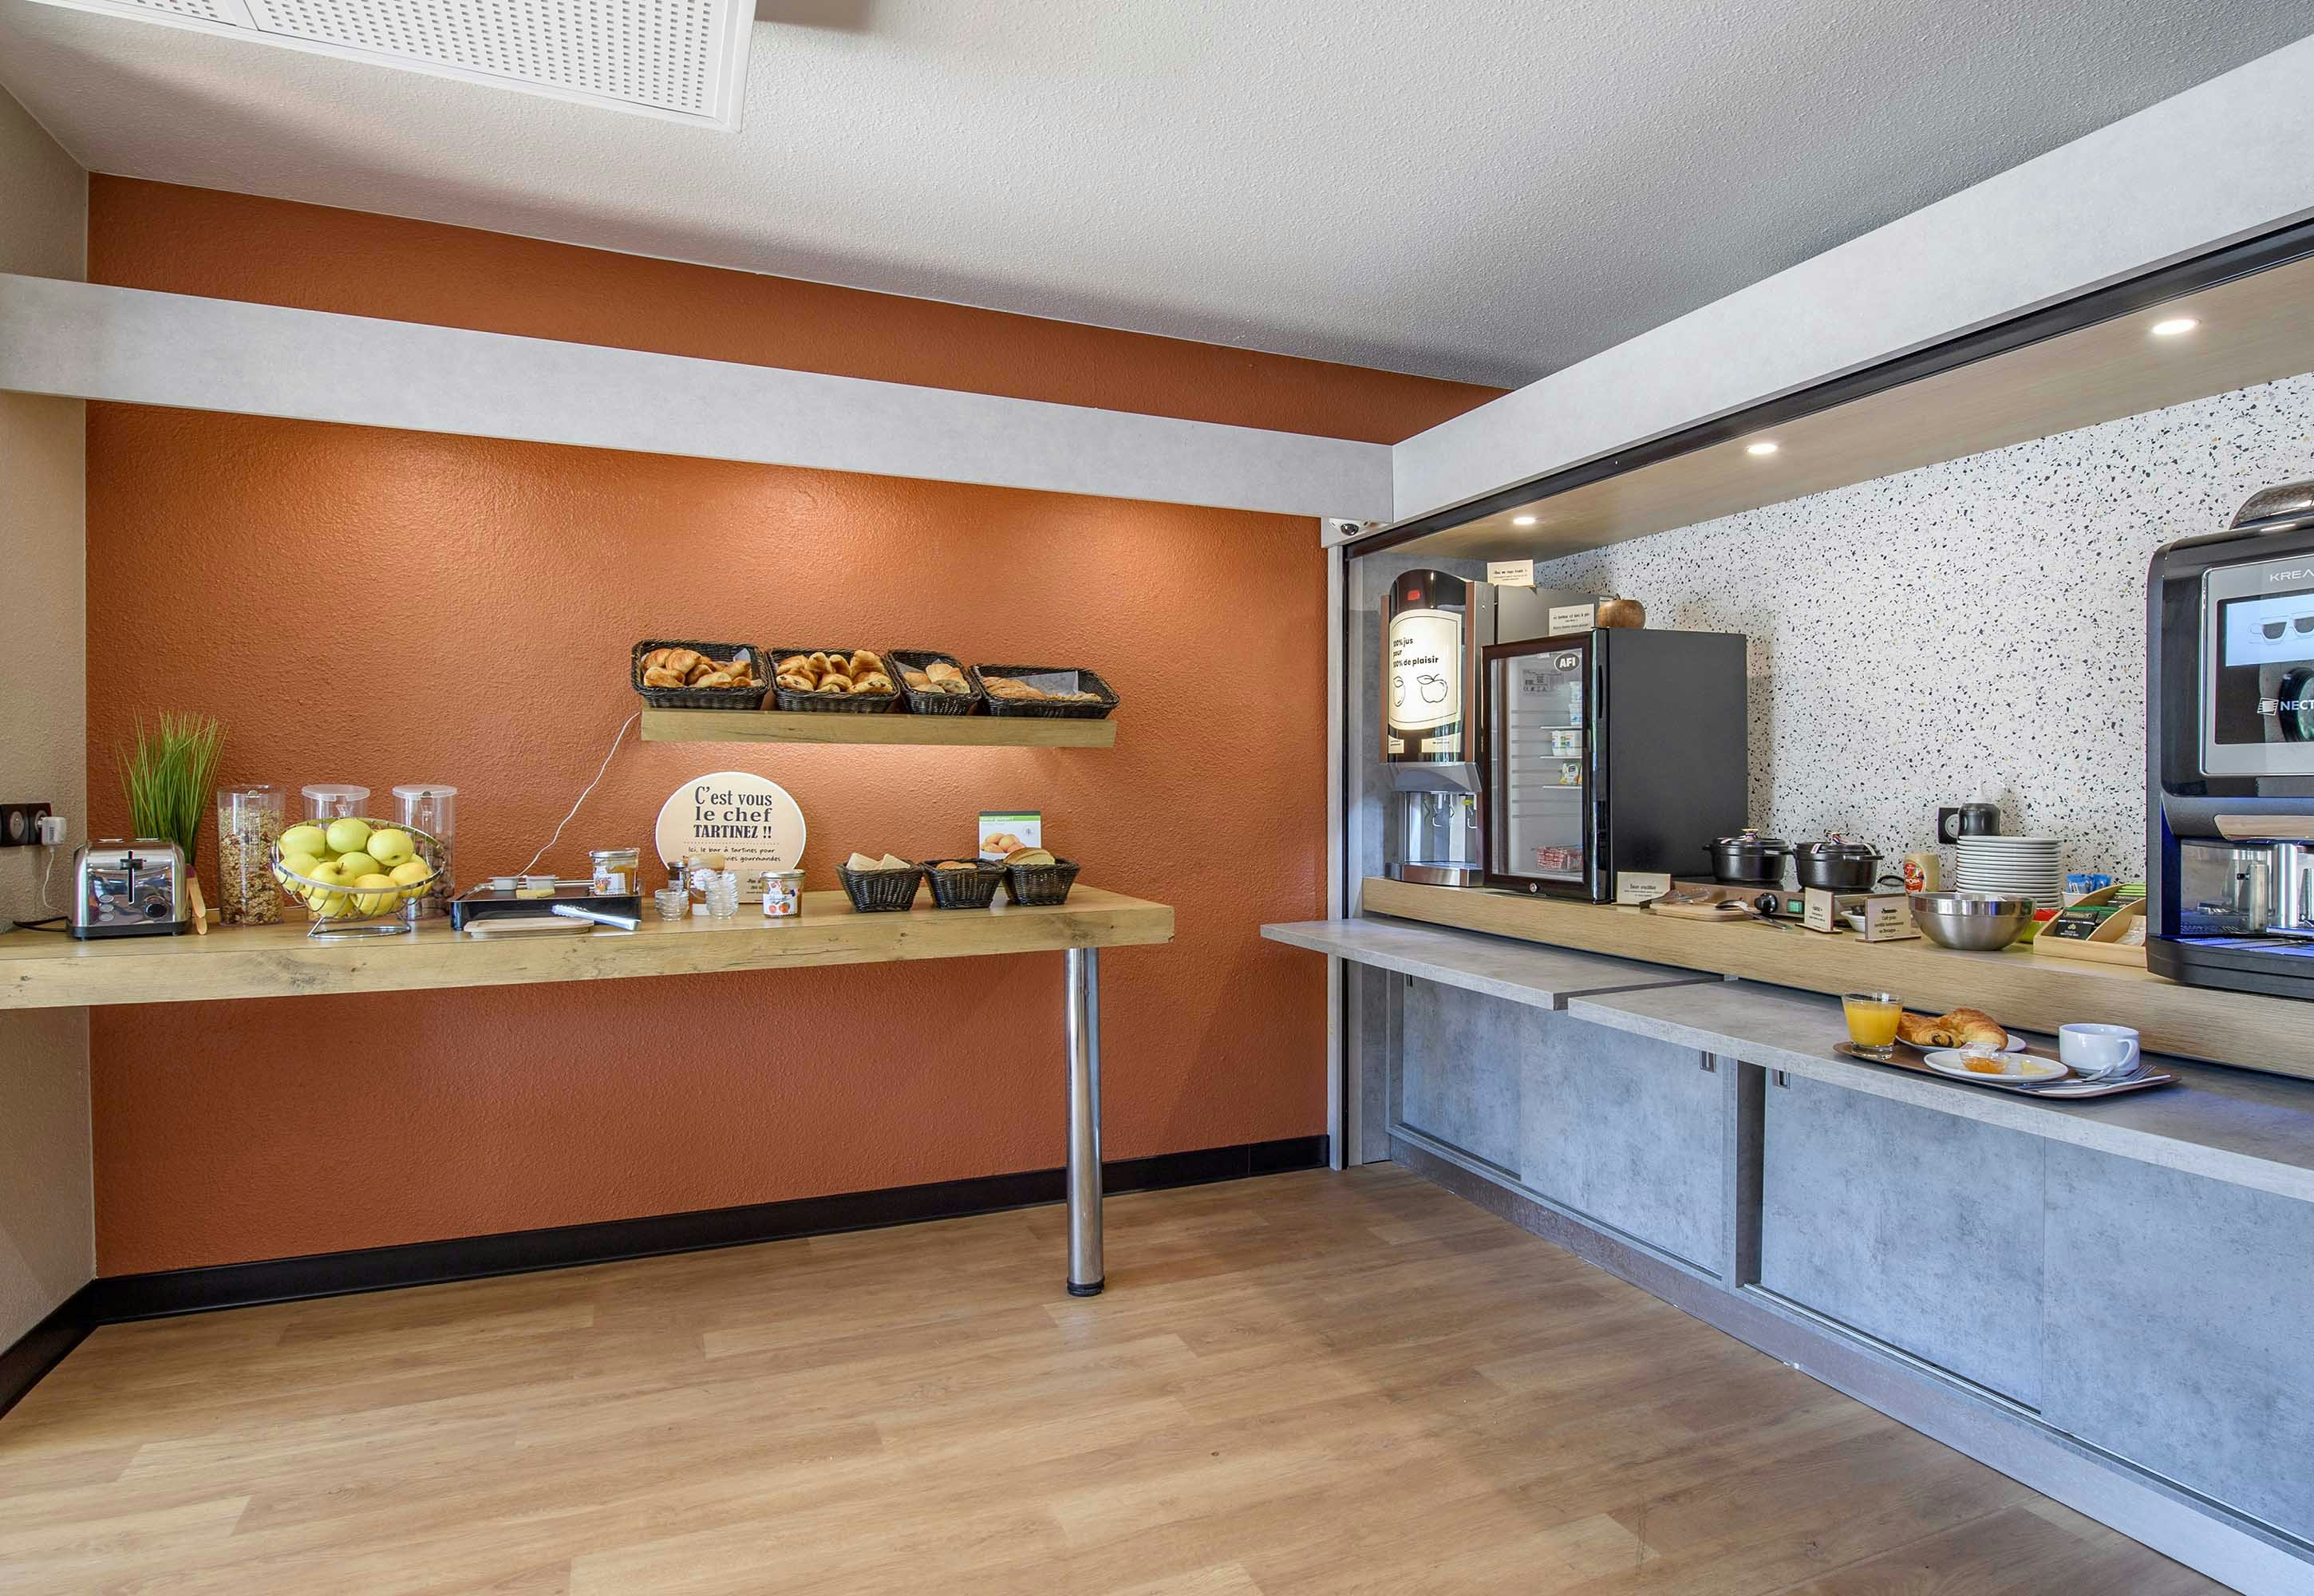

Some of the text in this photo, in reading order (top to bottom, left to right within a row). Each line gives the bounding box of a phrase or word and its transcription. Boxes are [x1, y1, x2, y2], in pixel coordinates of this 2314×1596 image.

[1403, 637, 1413, 647] jus
[1412, 655, 1439, 667] plaisir
[1559, 657, 1576, 668] AFI
[738, 794, 772, 806] vous
[695, 806, 772, 822] le chef
[693, 825, 772, 839] TARTINEZ !!
